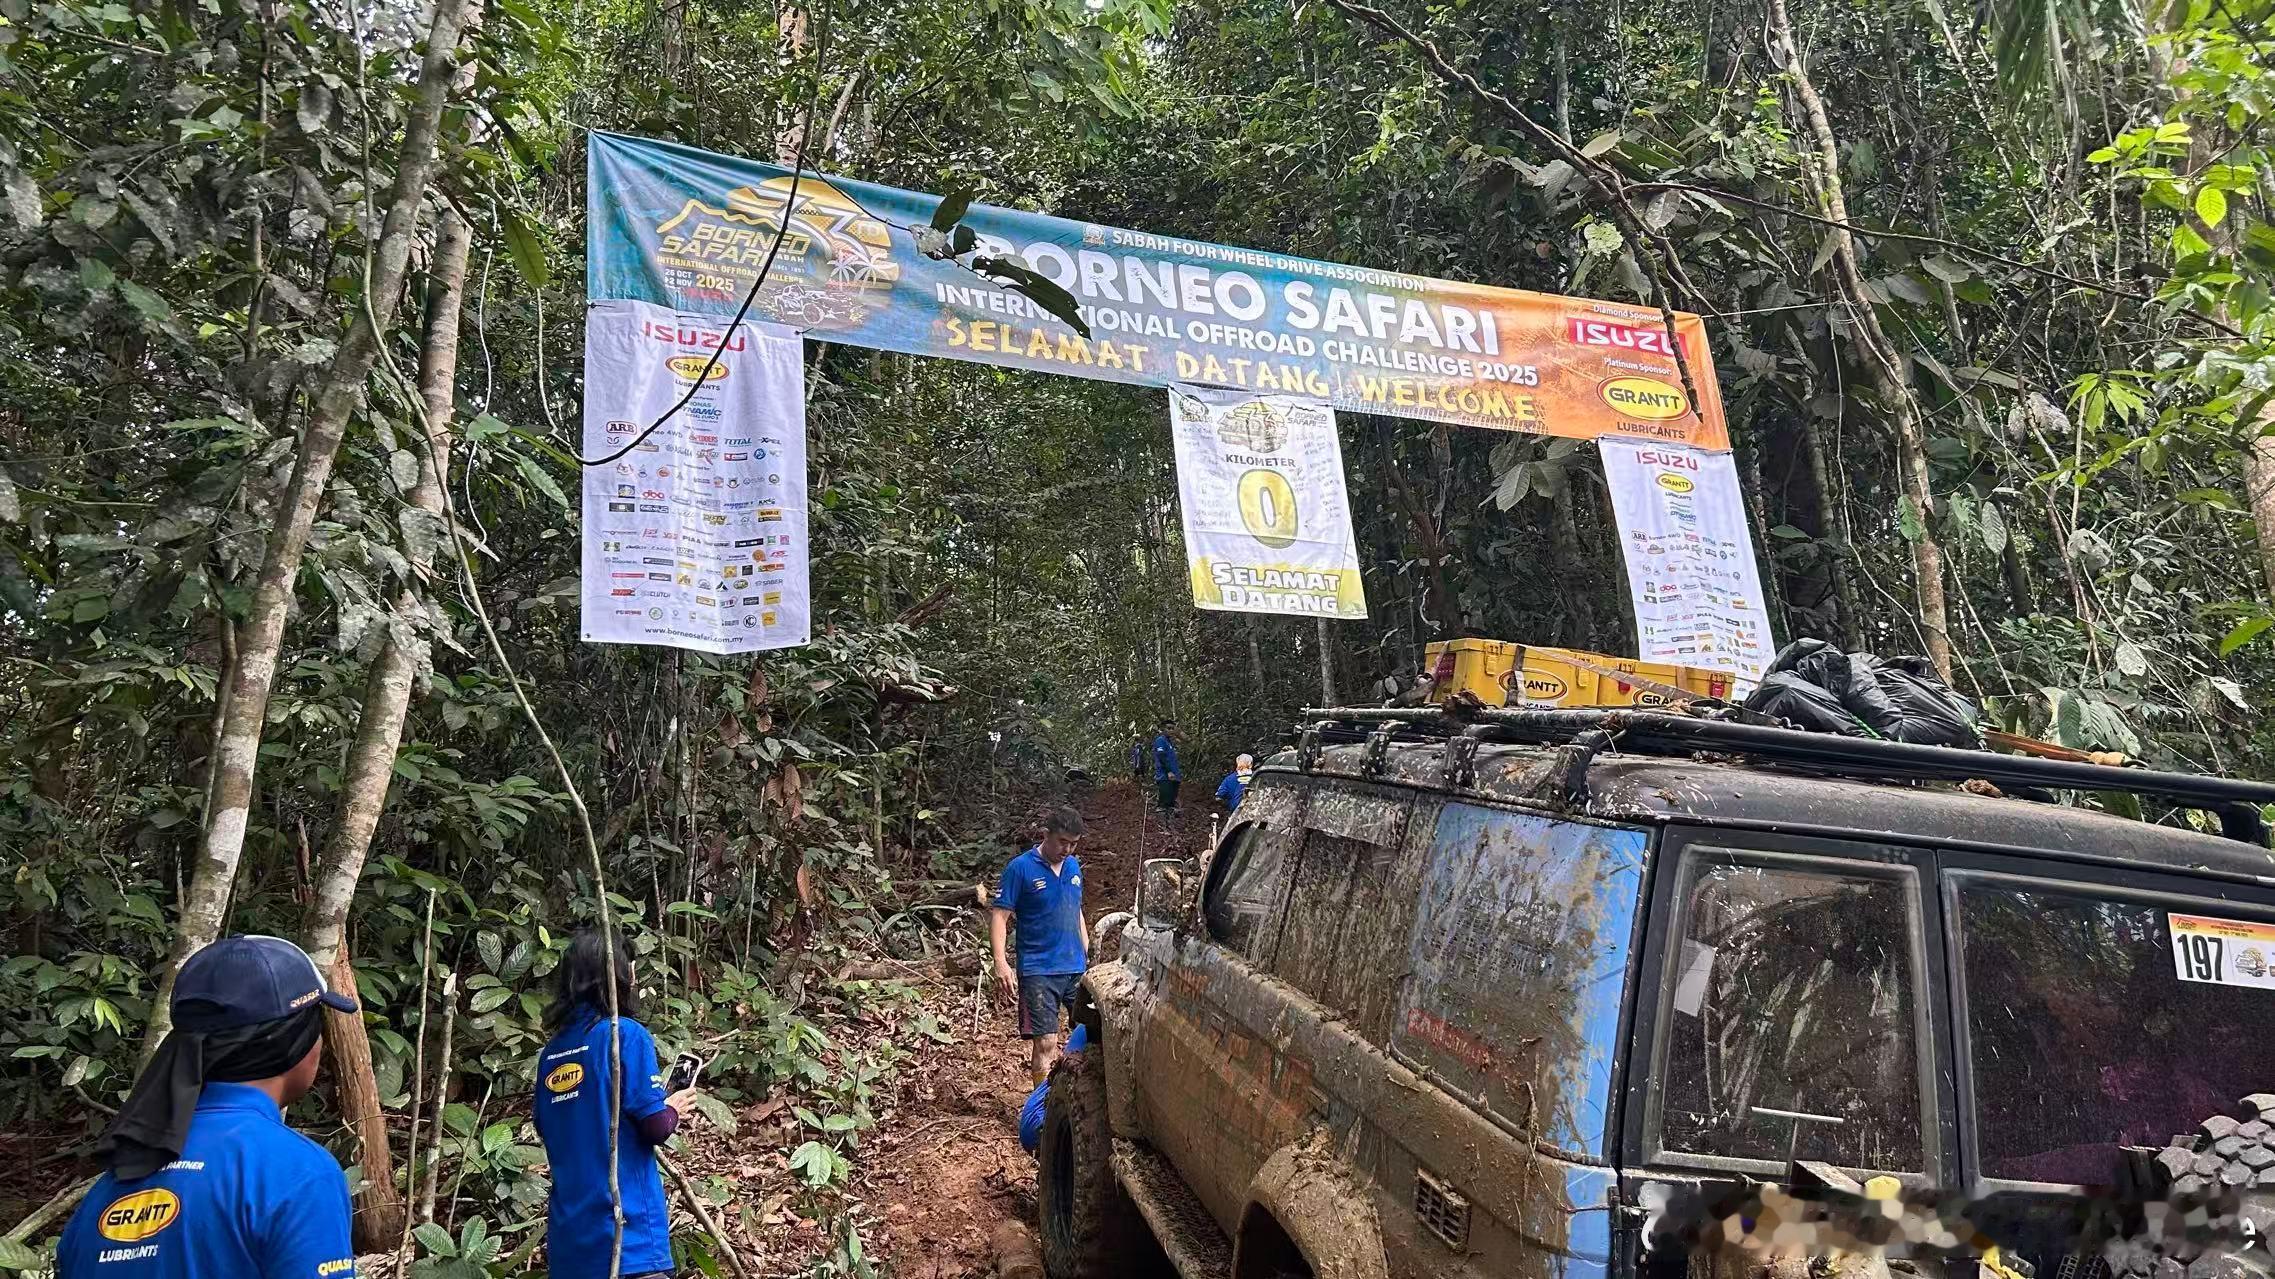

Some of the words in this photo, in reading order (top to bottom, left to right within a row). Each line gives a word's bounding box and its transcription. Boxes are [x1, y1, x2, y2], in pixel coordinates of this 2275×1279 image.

[658, 235, 769, 267] SAFARI
[692, 222, 812, 256] BORNEO
[656, 256, 719, 272] INTERNATIONAL
[721, 265, 757, 278] OFFROAD
[763, 272, 804, 284] HALLENGE
[677, 270, 693, 279] OCT
[1112, 230, 1169, 252] SABAH
[1173, 242, 1217, 258] FOUR
[1218, 248, 1274, 268] WHEEL
[1276, 256, 1324, 275] DRIVE
[1325, 264, 1425, 293] ASSOCIATION
[695, 273, 735, 292] 2025
[1283, 280, 1500, 356] SAFARI
[1593, 304, 1628, 319] Diamond
[642, 320, 746, 352] ISUZU
[935, 282, 1181, 339] INTERNTIONAL
[1186, 320, 1316, 358] OFFROAD
[1323, 340, 1472, 377] CHALLENGE
[1480, 359, 1539, 386] 2025
[945, 318, 1150, 372] SELAMAT
[1173, 350, 1330, 397] DATANG
[1359, 372, 1539, 421] WELCOME
[1604, 357, 1638, 371] Platinum
[1608, 387, 1680, 409] GRANTT
[1616, 421, 1685, 439] LUBRICANTS
[1225, 454, 1296, 467] KILOMETER
[1635, 450, 1698, 471] ISUZU
[1237, 469, 1299, 549] 0
[1211, 562, 1340, 593] SELAMAT
[1220, 584, 1339, 612] DATANG
[645, 627, 744, 644] www.borneosafari.com.my
[2177, 933, 2223, 982] 197
